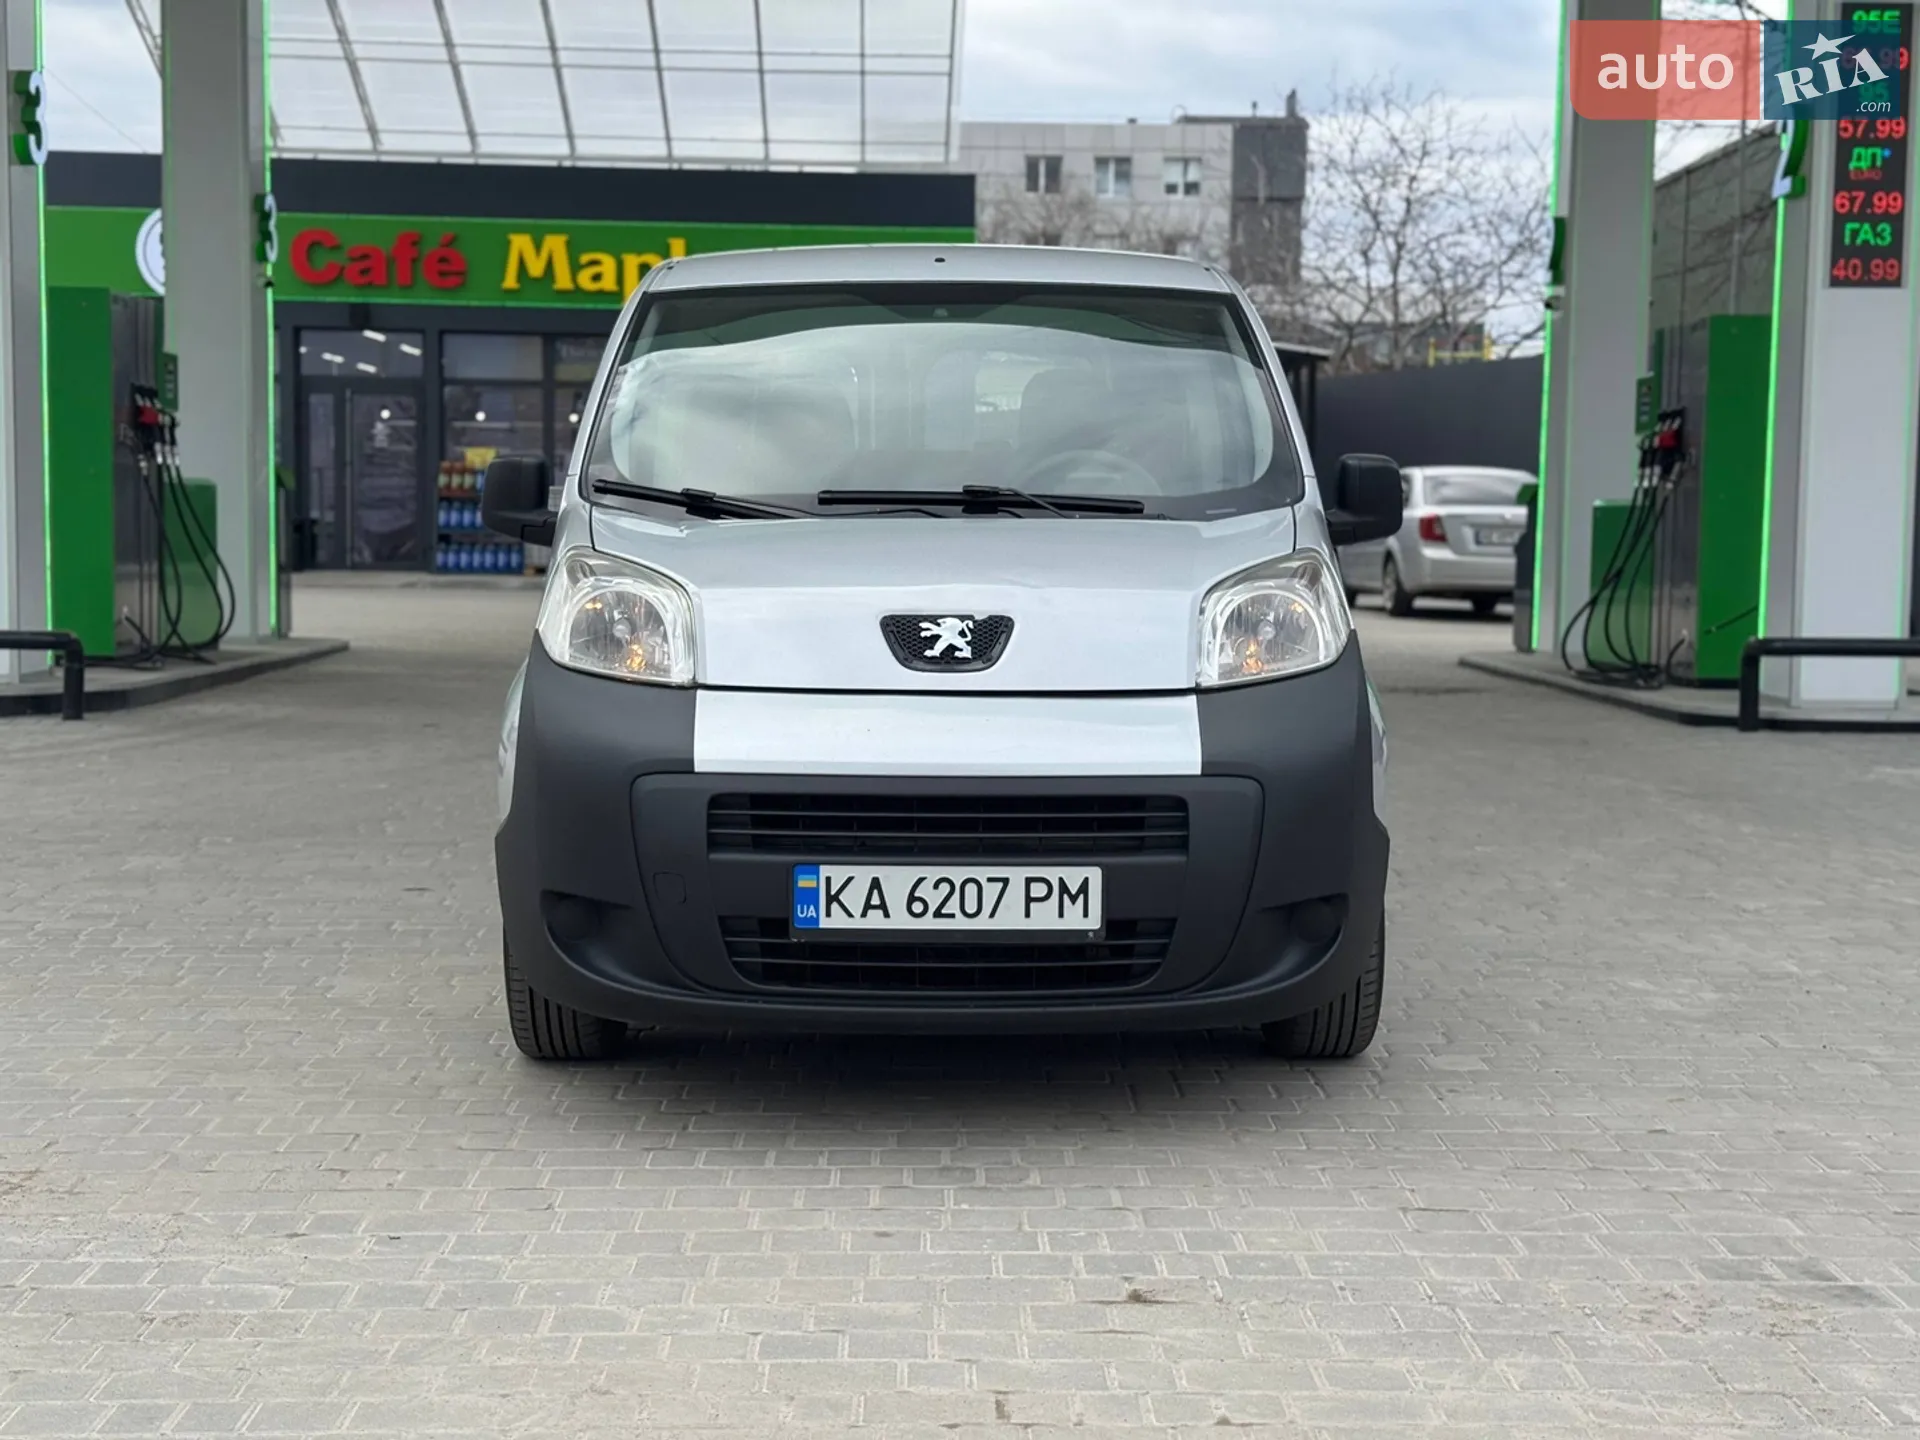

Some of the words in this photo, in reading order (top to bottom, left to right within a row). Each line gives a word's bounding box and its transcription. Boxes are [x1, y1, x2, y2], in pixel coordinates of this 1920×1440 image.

[1839, 115, 1906, 139] 57.99
[1834, 190, 1903, 214] 67.99
[1844, 221, 1892, 246] ГАЗ
[290, 228, 467, 288] Café
[1832, 258, 1899, 281] 40.99
[905, 876, 1010, 919] 6207
[1024, 876, 1090, 919] PM
[797, 904, 817, 918] UA
